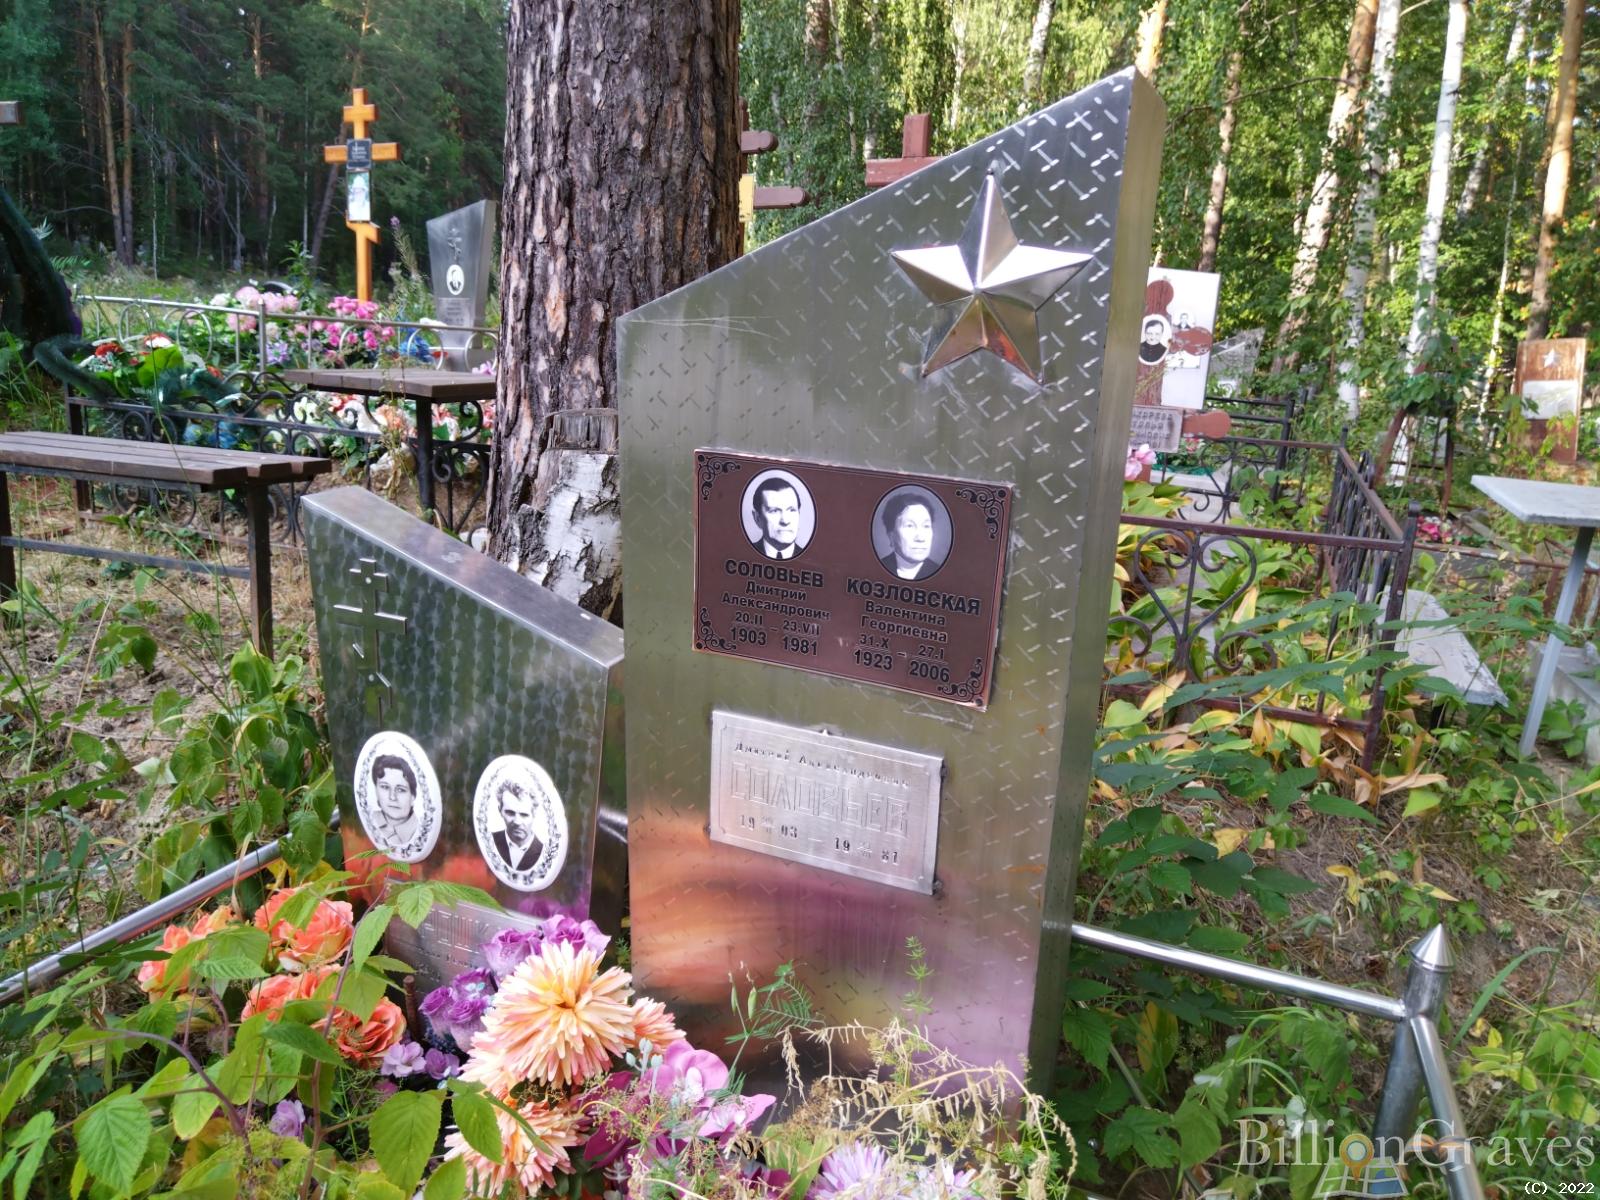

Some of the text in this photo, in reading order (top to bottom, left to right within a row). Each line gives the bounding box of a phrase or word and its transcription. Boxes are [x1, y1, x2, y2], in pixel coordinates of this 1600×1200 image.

[725, 559, 824, 588] СОЛОВЬЕВ
[746, 581, 807, 601] Дмитрий
[847, 578, 981, 616] КОЗЛОВСКАЯ
[722, 592, 831, 620] Александрович
[865, 600, 946, 626] Валентина
[731, 627, 818, 656] 1903 1981
[861, 615, 948, 643] Георгиевна
[855, 649, 950, 683] 1923 2006
